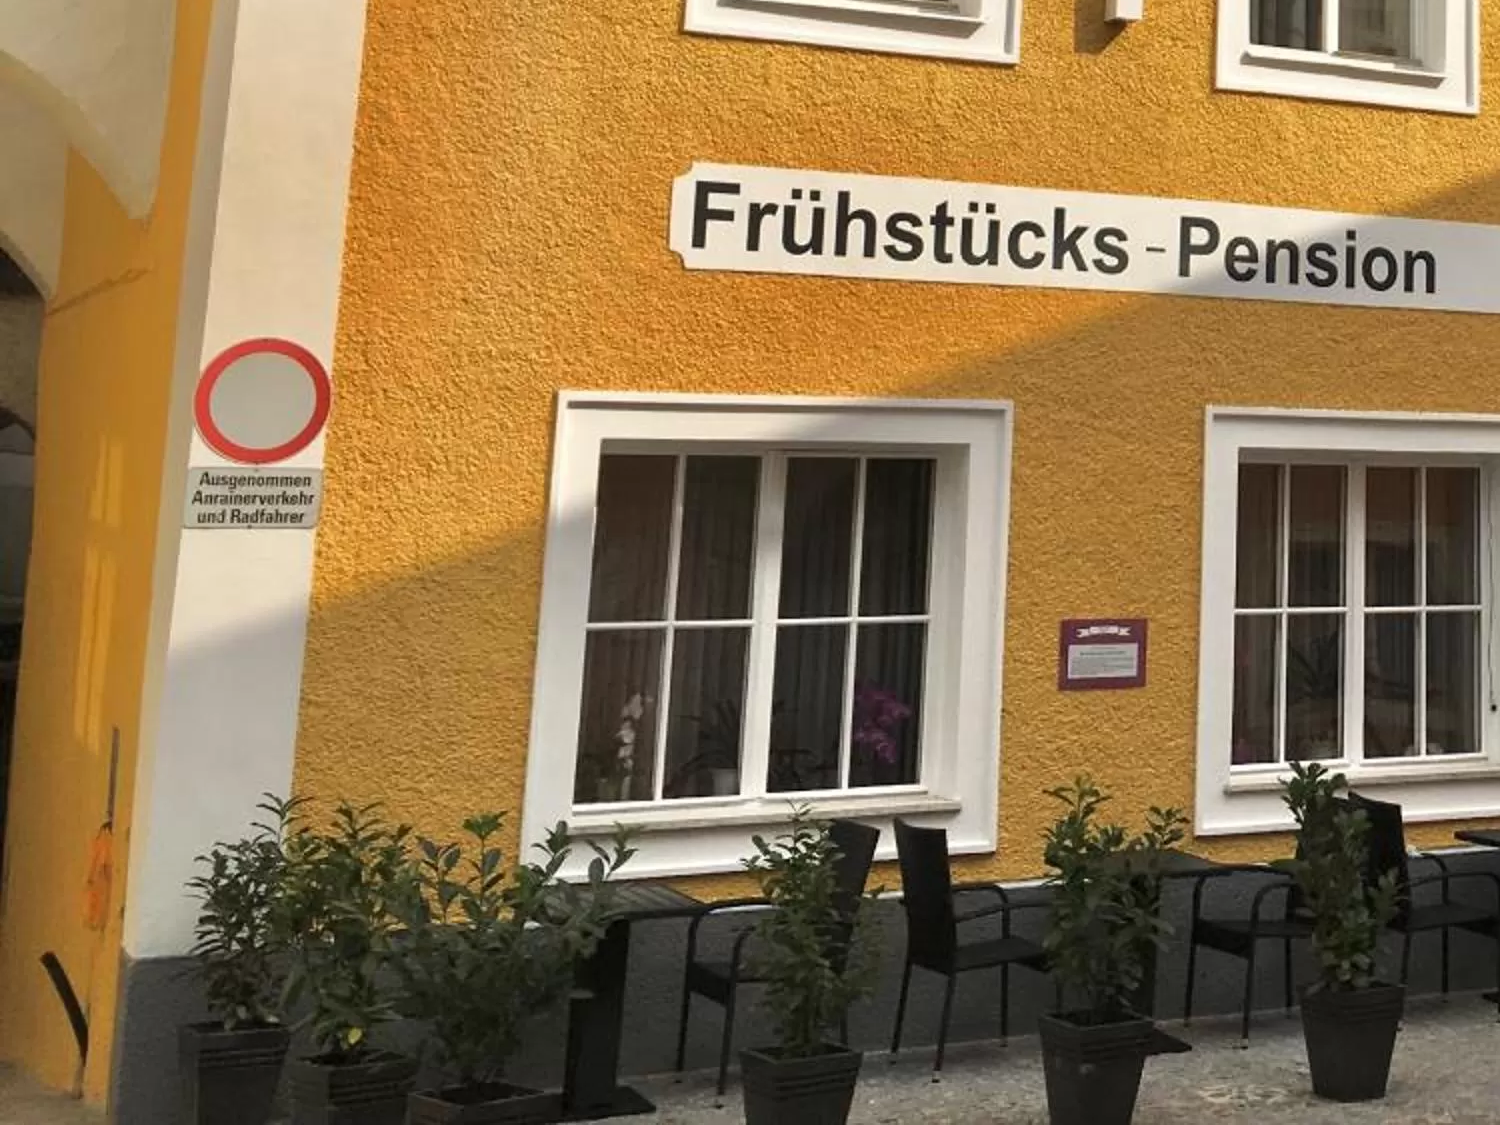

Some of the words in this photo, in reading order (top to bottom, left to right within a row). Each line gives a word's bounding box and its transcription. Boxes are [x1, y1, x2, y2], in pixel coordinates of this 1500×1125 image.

[199, 471, 312, 490] Ausgenommen
[191, 490, 315, 505] Anrainerverkehr
[197, 509, 226, 524] und
[230, 508, 305, 524] Radfahrer
